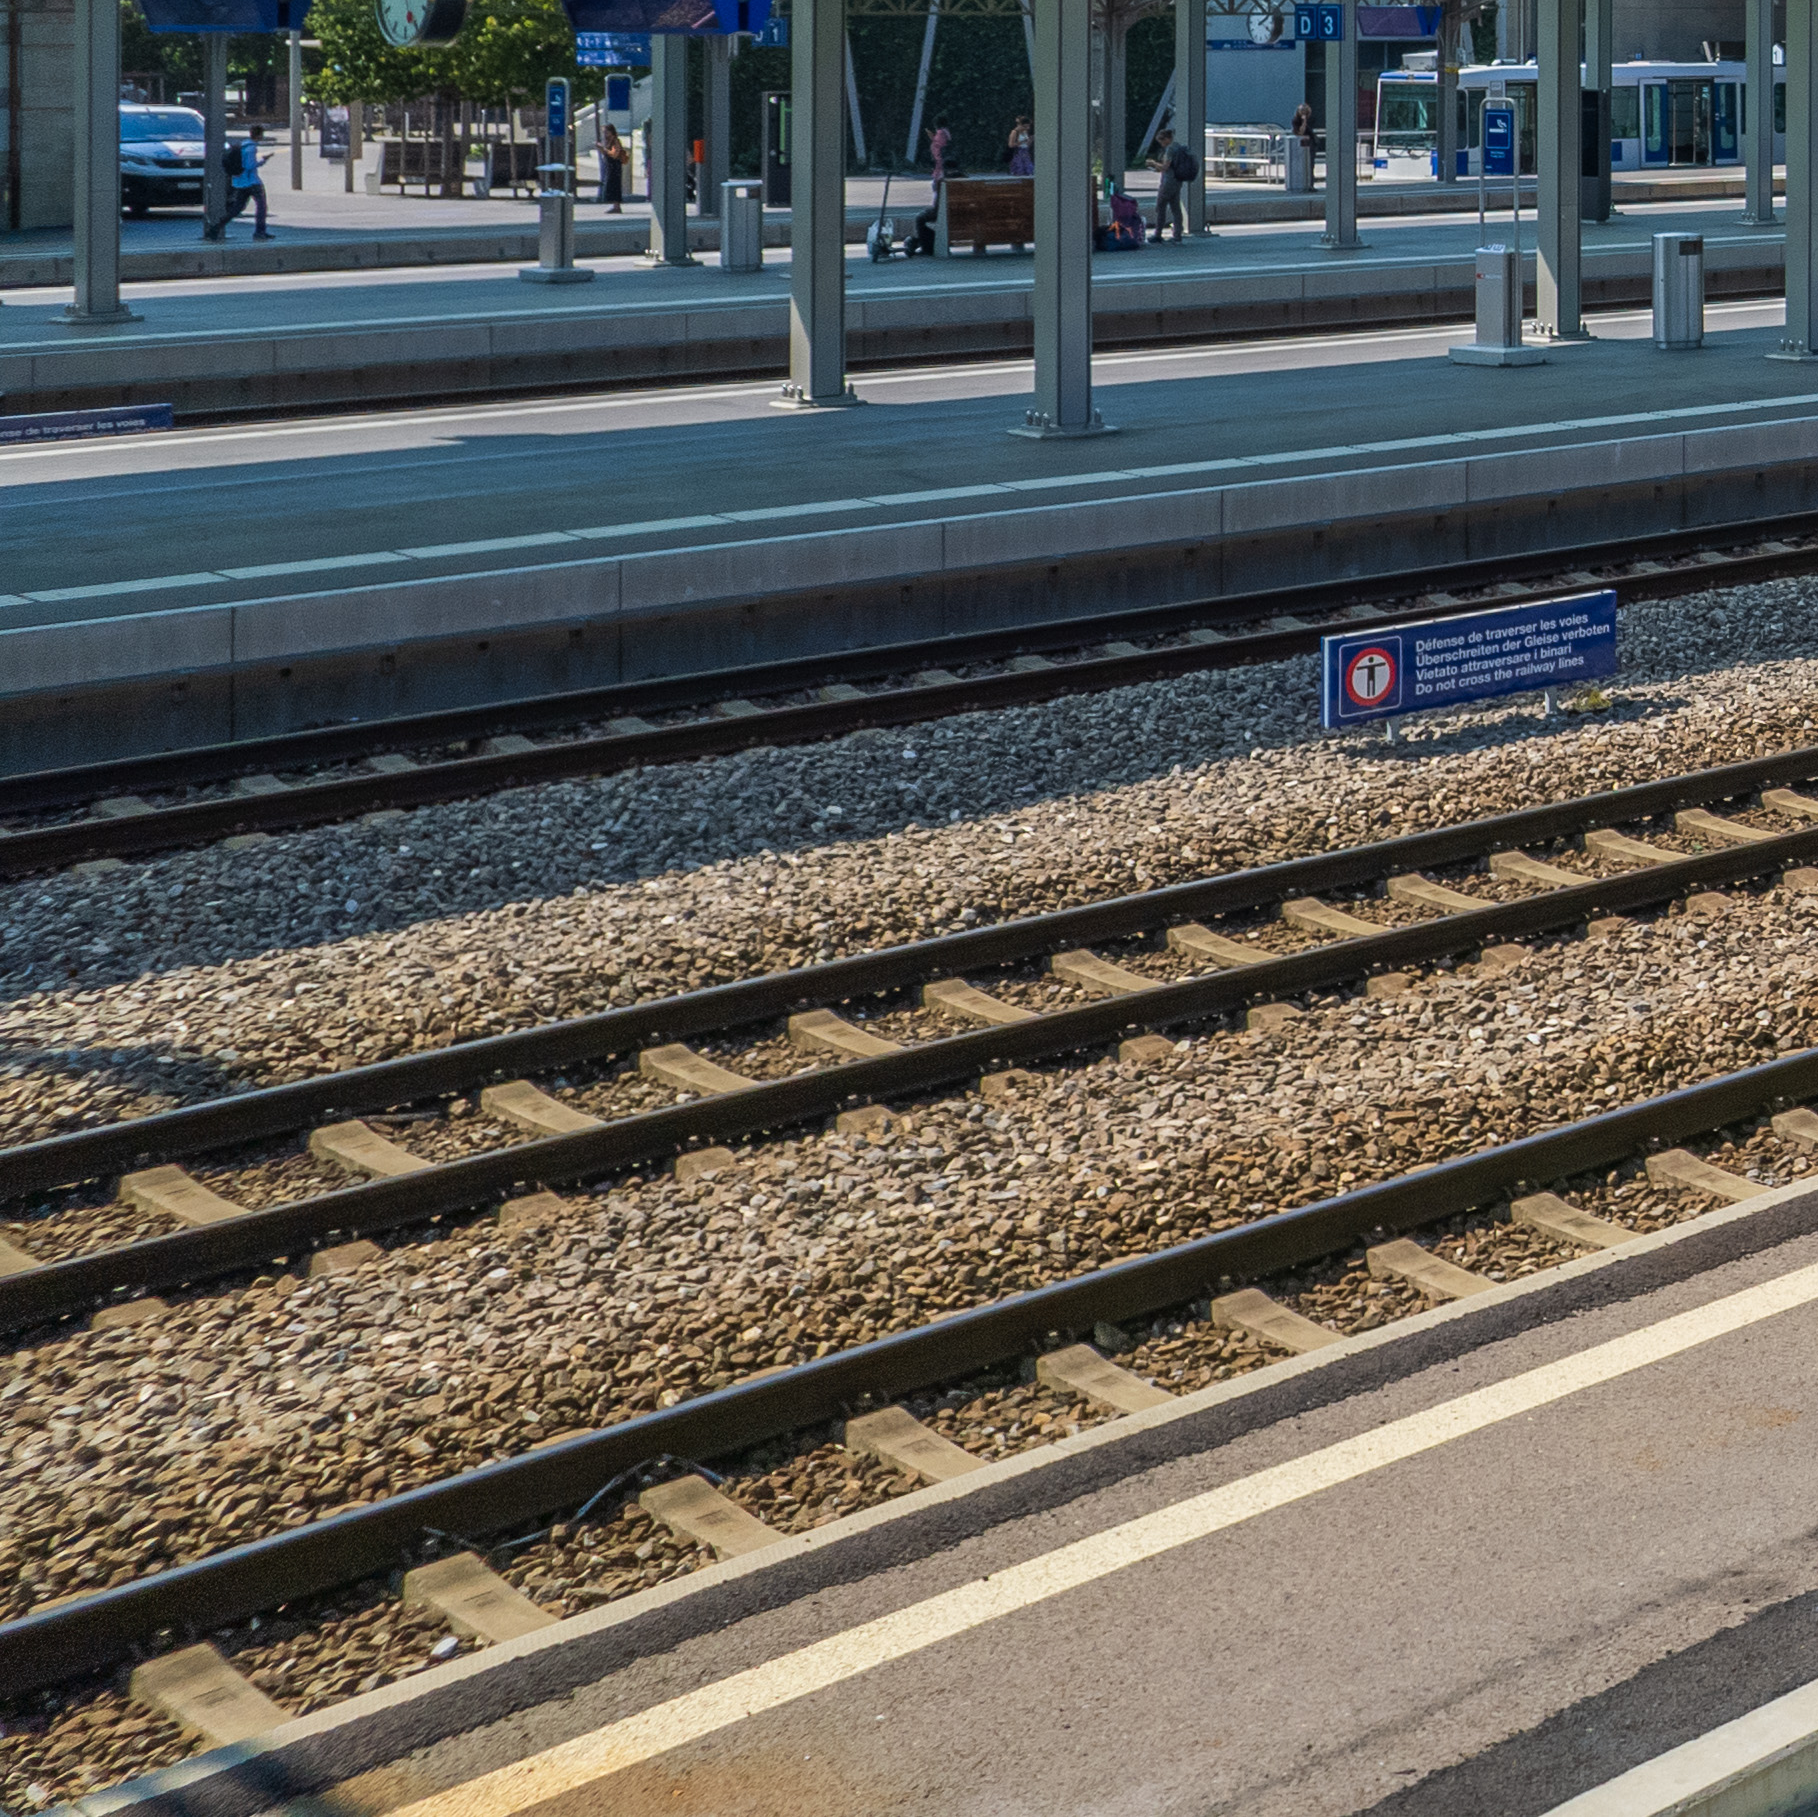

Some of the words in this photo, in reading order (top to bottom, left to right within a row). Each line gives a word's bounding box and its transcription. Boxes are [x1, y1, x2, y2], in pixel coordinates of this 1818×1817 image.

[1300, 16, 1311, 34] D
[1324, 15, 1334, 34] 3
[97, 420, 114, 429] les
[116, 418, 146, 427] voies
[1415, 636, 1465, 653] Défense
[1468, 631, 1483, 643] de
[1485, 623, 1538, 641] traverser
[1540, 619, 1556, 631] les
[1559, 614, 1588, 627] voies
[1415, 644, 1500, 667] Überschreiten
[1502, 639, 1521, 651] der
[1524, 633, 1559, 648] Gleise
[1562, 624, 1610, 641] verboten
[1415, 665, 1458, 681] Vietato
[1461, 653, 1531, 674] attraversare
[1540, 642, 1572, 659] binari
[1415, 683, 1433, 695] Do
[1436, 678, 1456, 692] not
[1458, 673, 1491, 687] cross
[1494, 669, 1513, 681] the
[1515, 660, 1556, 677] railway
[1558, 656, 1584, 669] lines
